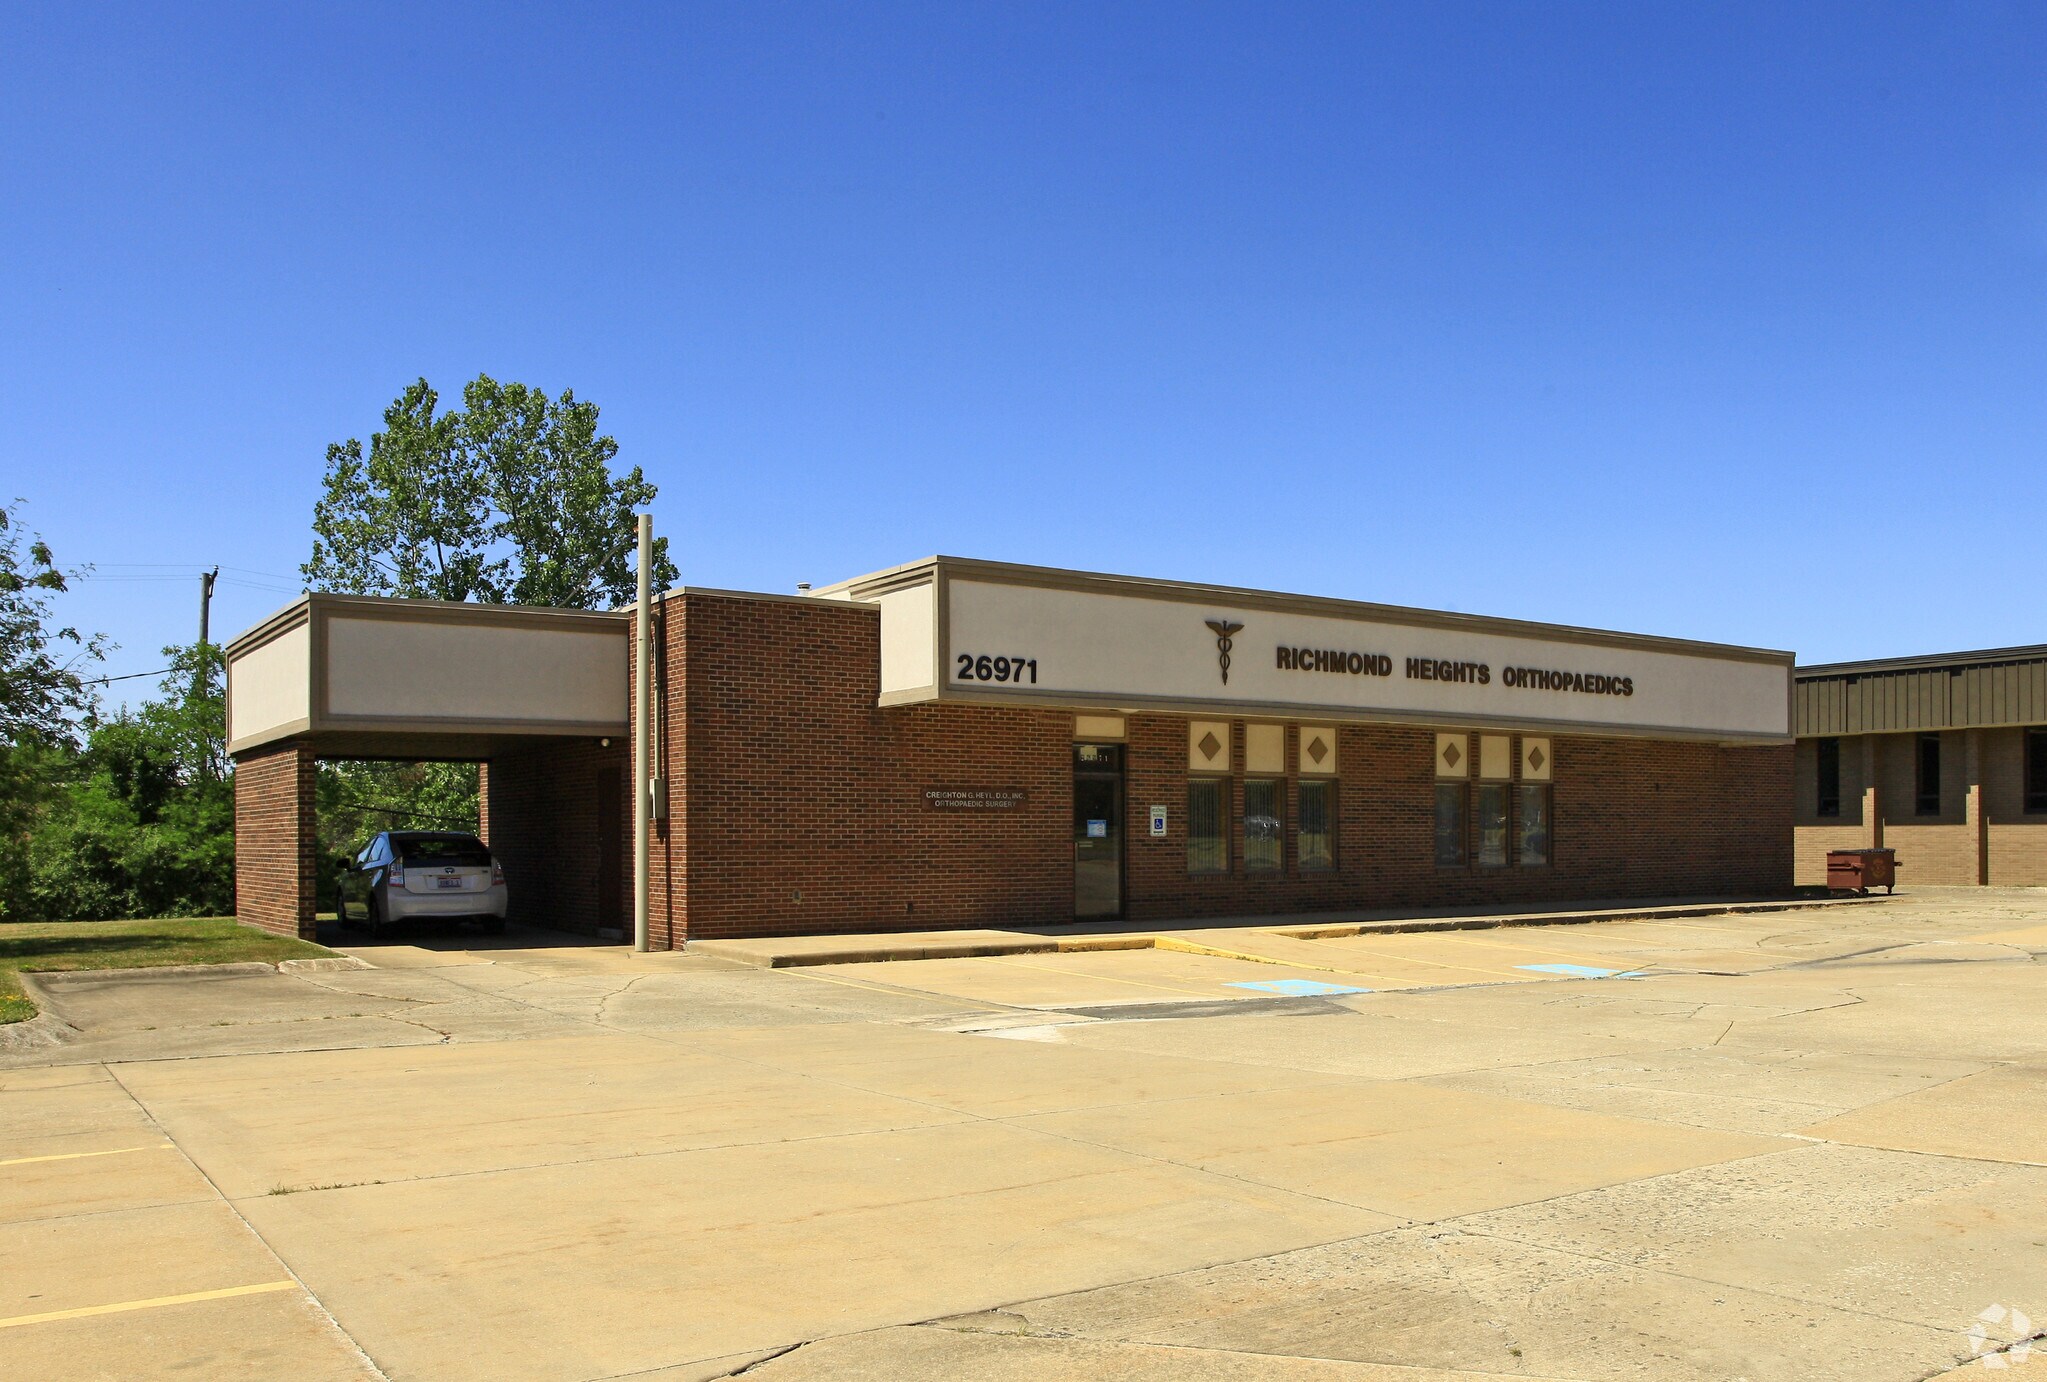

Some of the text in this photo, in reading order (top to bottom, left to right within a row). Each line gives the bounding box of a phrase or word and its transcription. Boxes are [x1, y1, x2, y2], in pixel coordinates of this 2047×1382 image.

[957, 654, 1037, 684] 26971
[1276, 647, 1633, 696] RICHMOND HEIGHTS ORTHOPAEDICS
[926, 791, 967, 799] CREIGHTON
